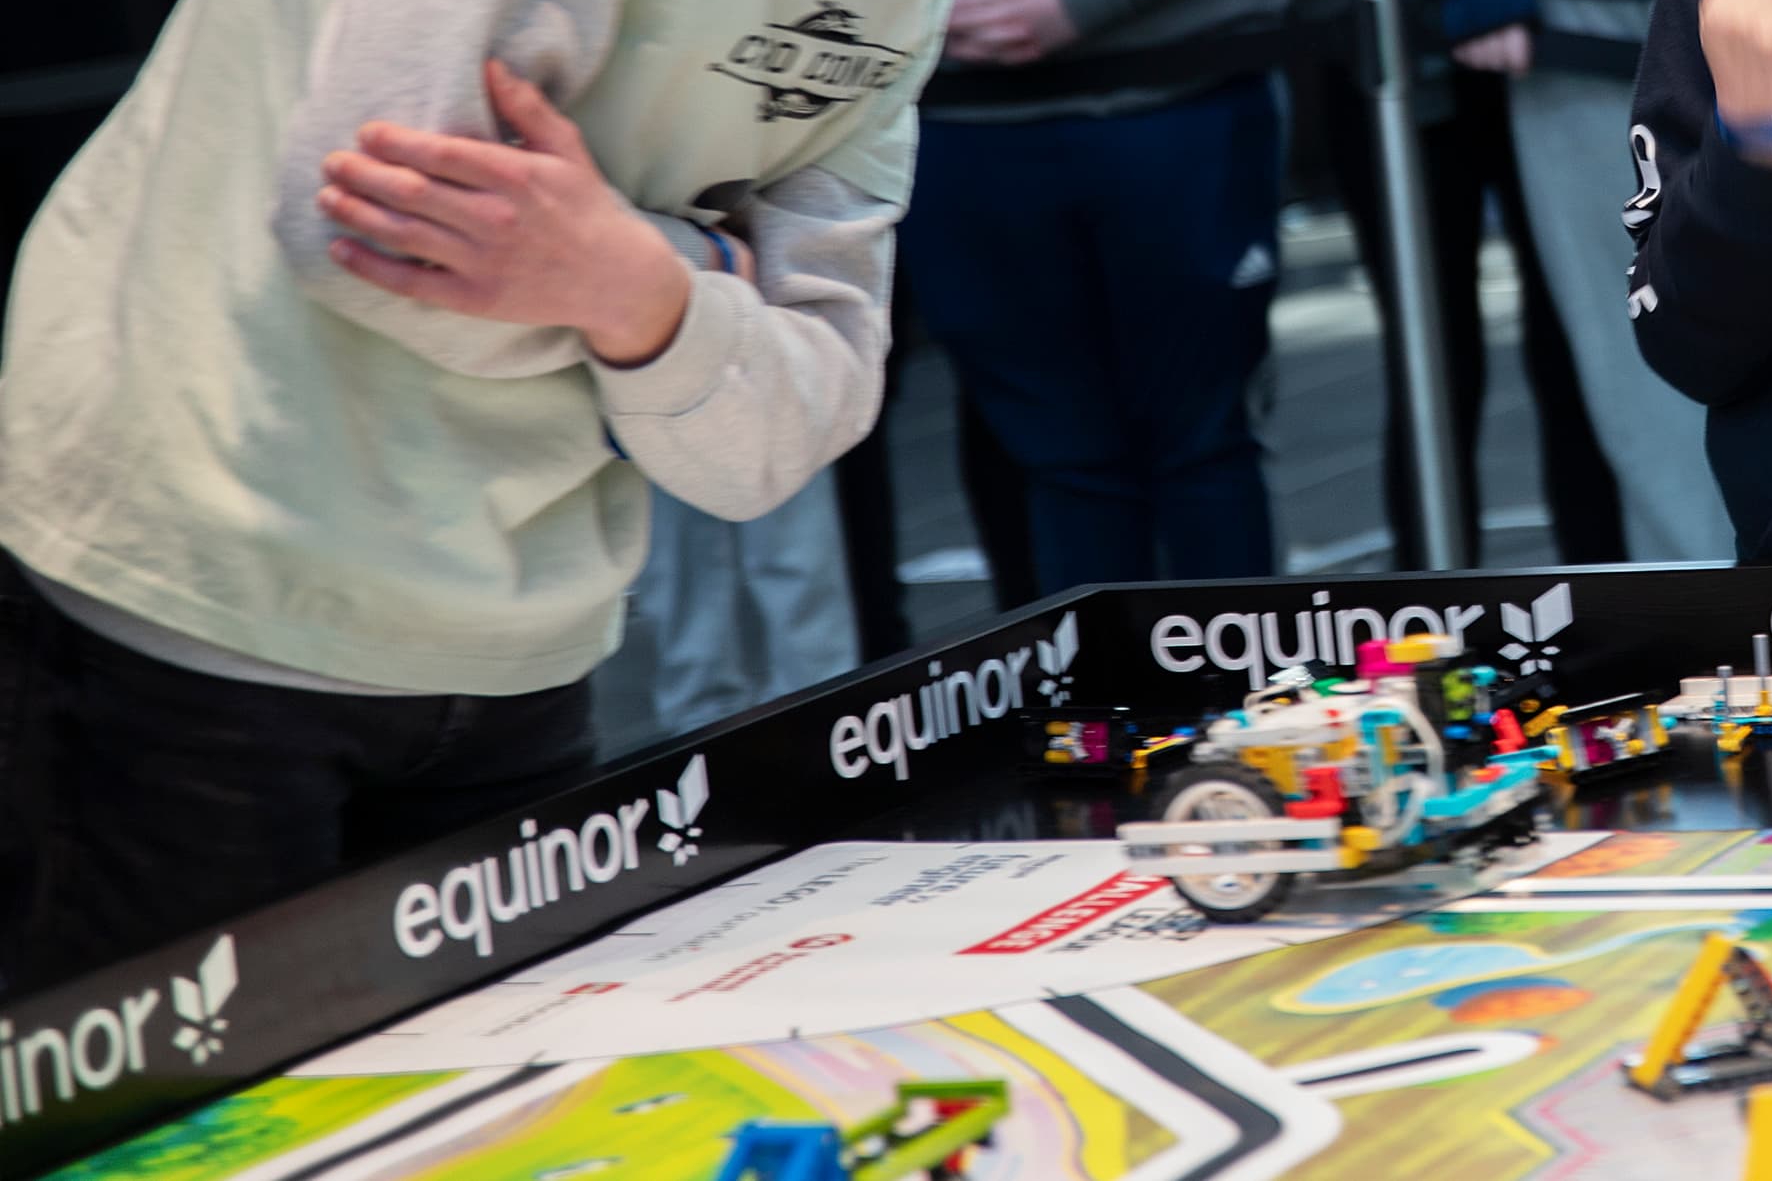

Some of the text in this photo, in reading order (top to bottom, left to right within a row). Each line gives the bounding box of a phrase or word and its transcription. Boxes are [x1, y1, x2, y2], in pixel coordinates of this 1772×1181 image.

[1150, 590, 1486, 692] equinor
[829, 646, 1032, 781] equinor
[394, 798, 649, 957] equinor
[993, 875, 1165, 951] ALLENGE
[0, 987, 161, 1127] inor
